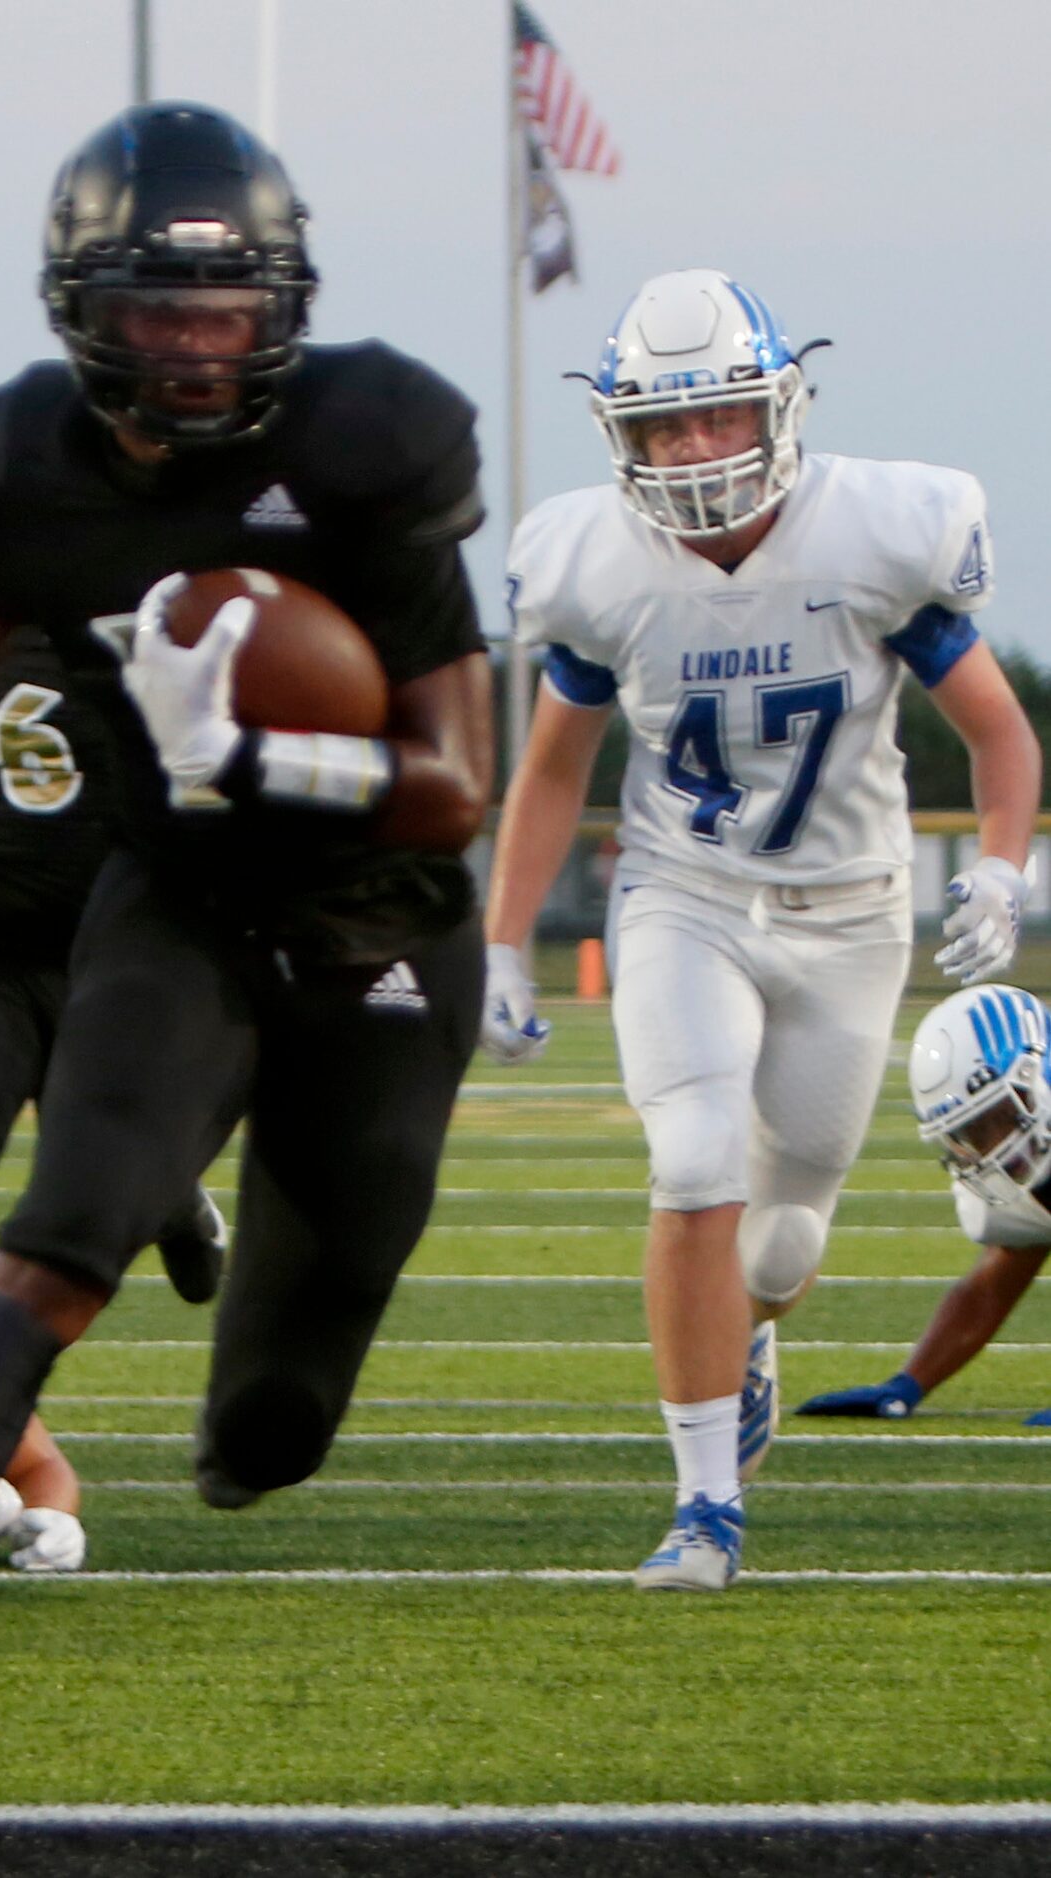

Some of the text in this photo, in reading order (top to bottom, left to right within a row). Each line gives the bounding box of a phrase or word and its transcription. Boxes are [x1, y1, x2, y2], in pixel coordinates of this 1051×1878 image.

[951, 521, 987, 596] 4
[681, 642, 793, 681] LINDALE
[662, 670, 853, 855] 47
